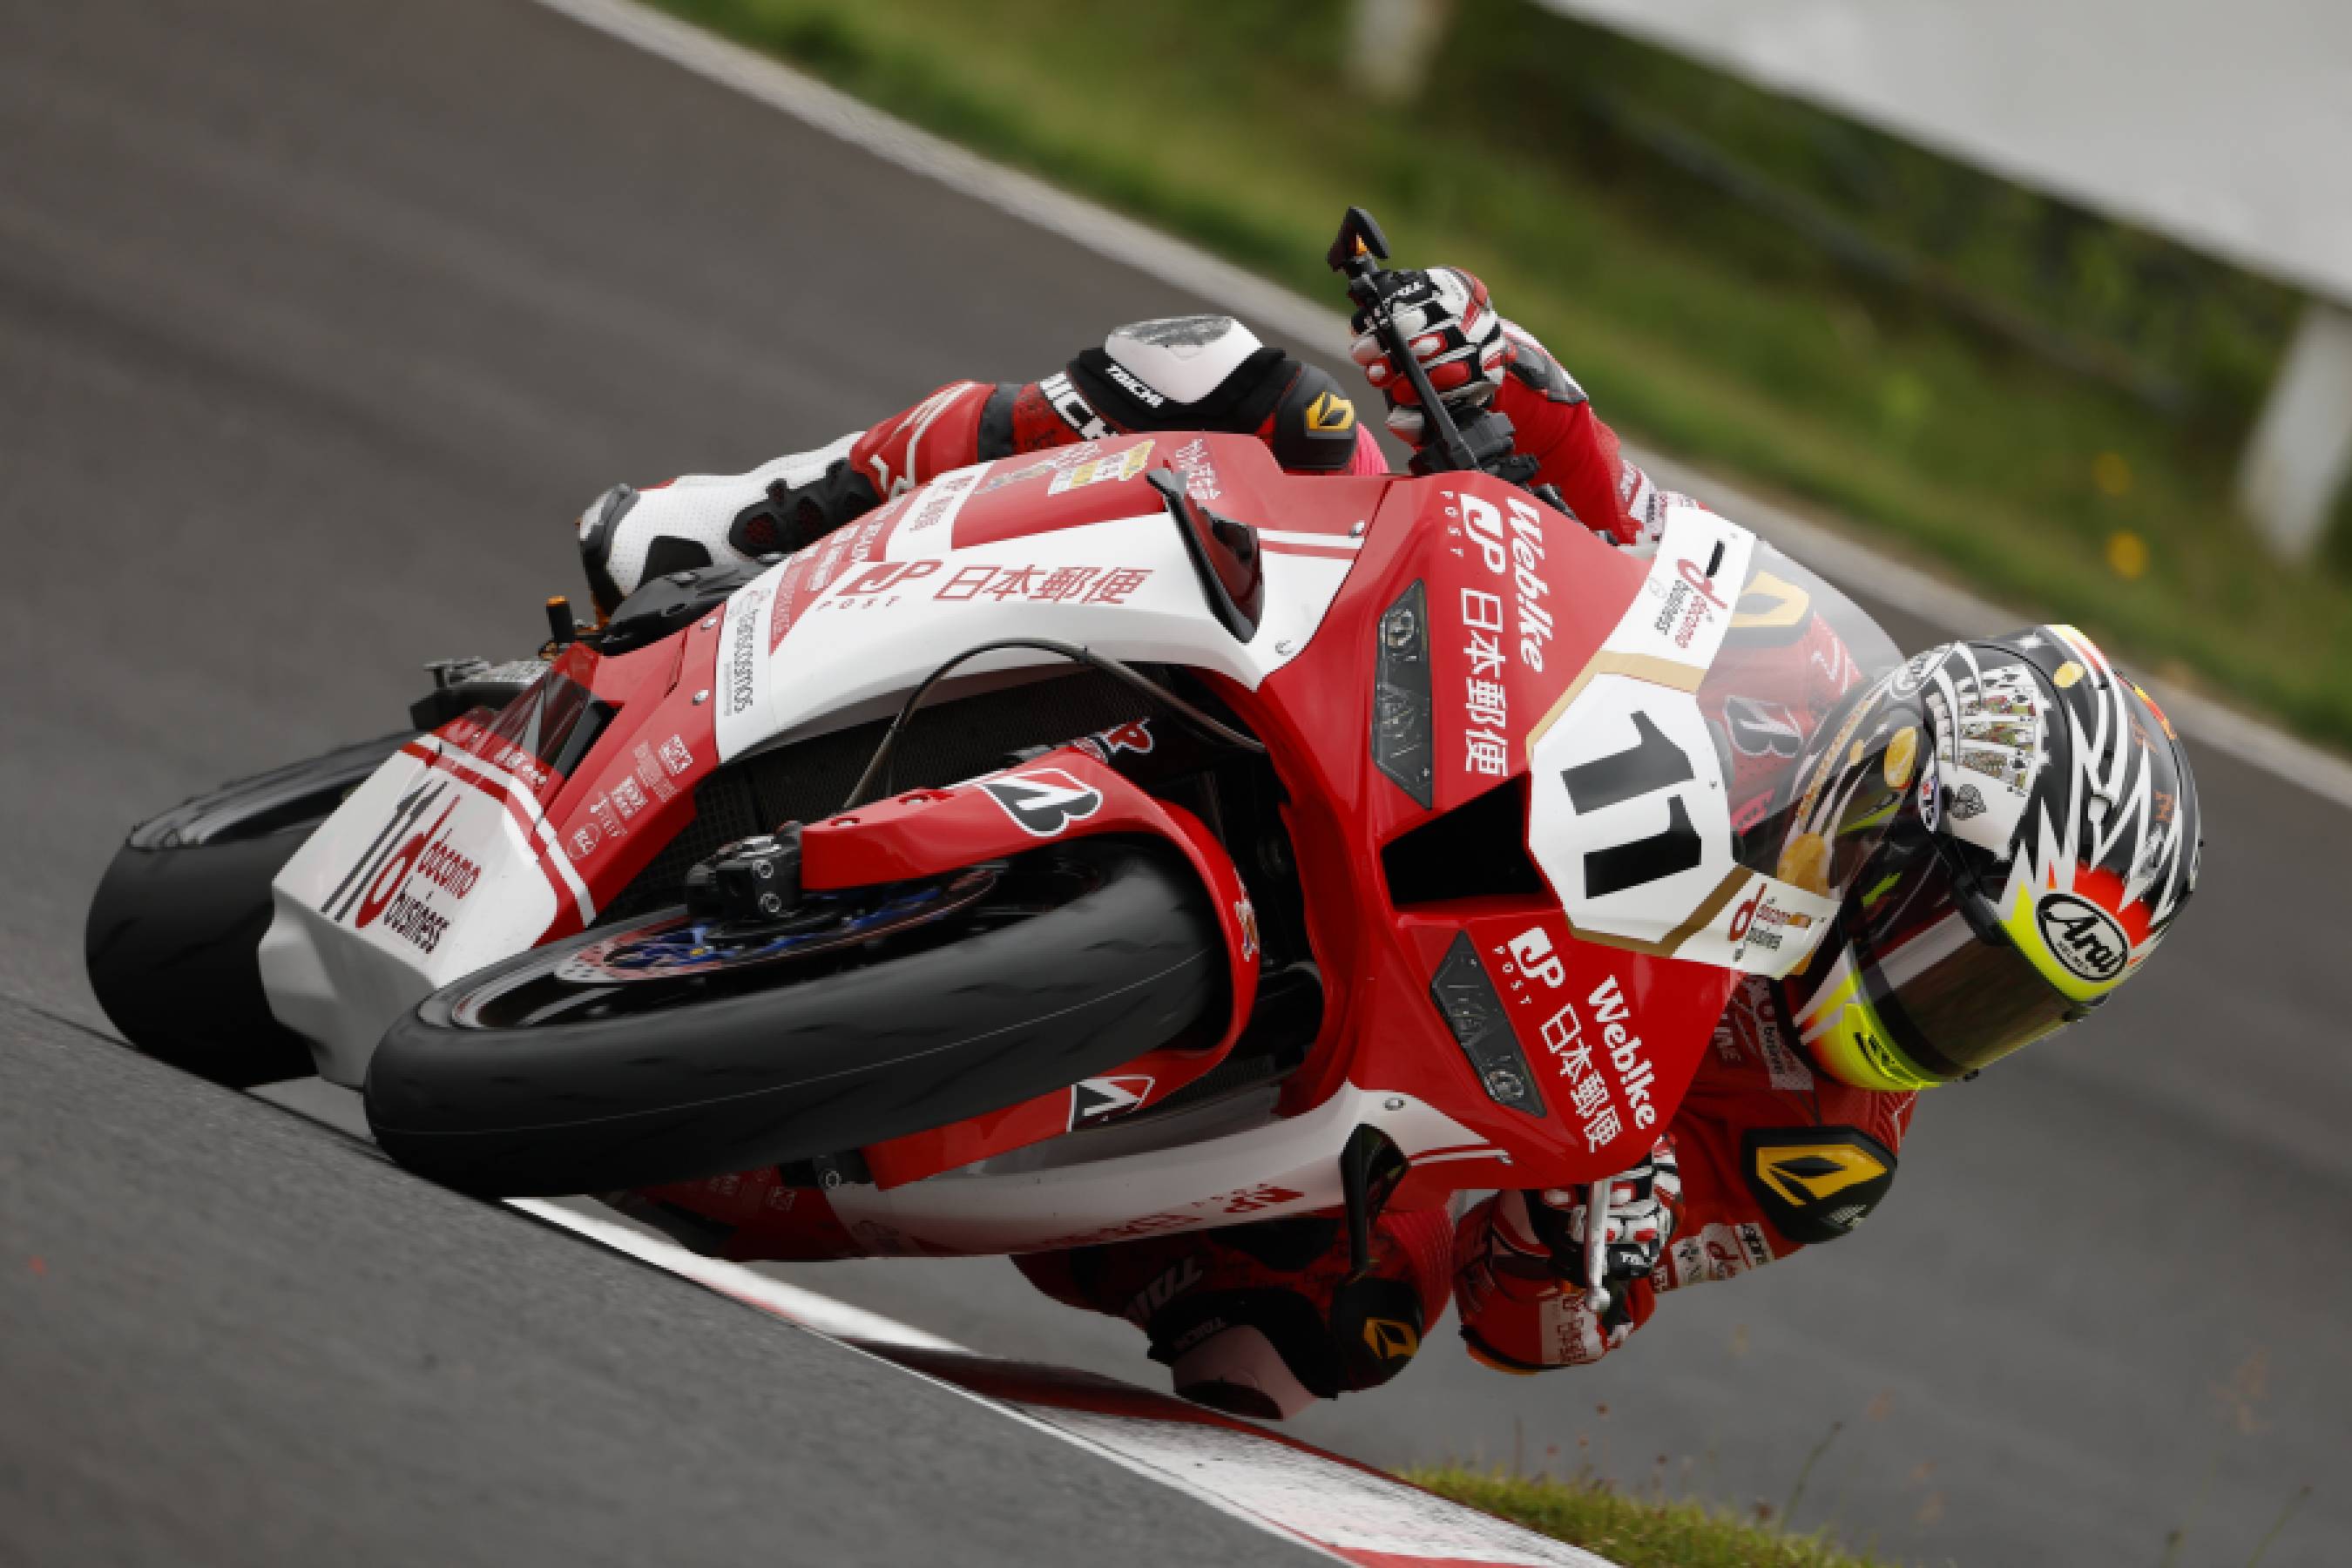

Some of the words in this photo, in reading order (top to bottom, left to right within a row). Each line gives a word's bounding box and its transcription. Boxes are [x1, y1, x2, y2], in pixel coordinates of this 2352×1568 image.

[1460, 492, 1506, 576] JP
[835, 558, 943, 597] JP
[932, 564, 1154, 605] 日本郵便
[1460, 586, 1509, 778] 日本郵便
[1559, 710, 1702, 900] 11
[417, 828, 482, 900] docomo
[383, 873, 451, 955] business
[2040, 908, 2119, 973] Arai
[1508, 926, 1566, 989] JP
[1538, 1003, 1623, 1154] 日本郵便
